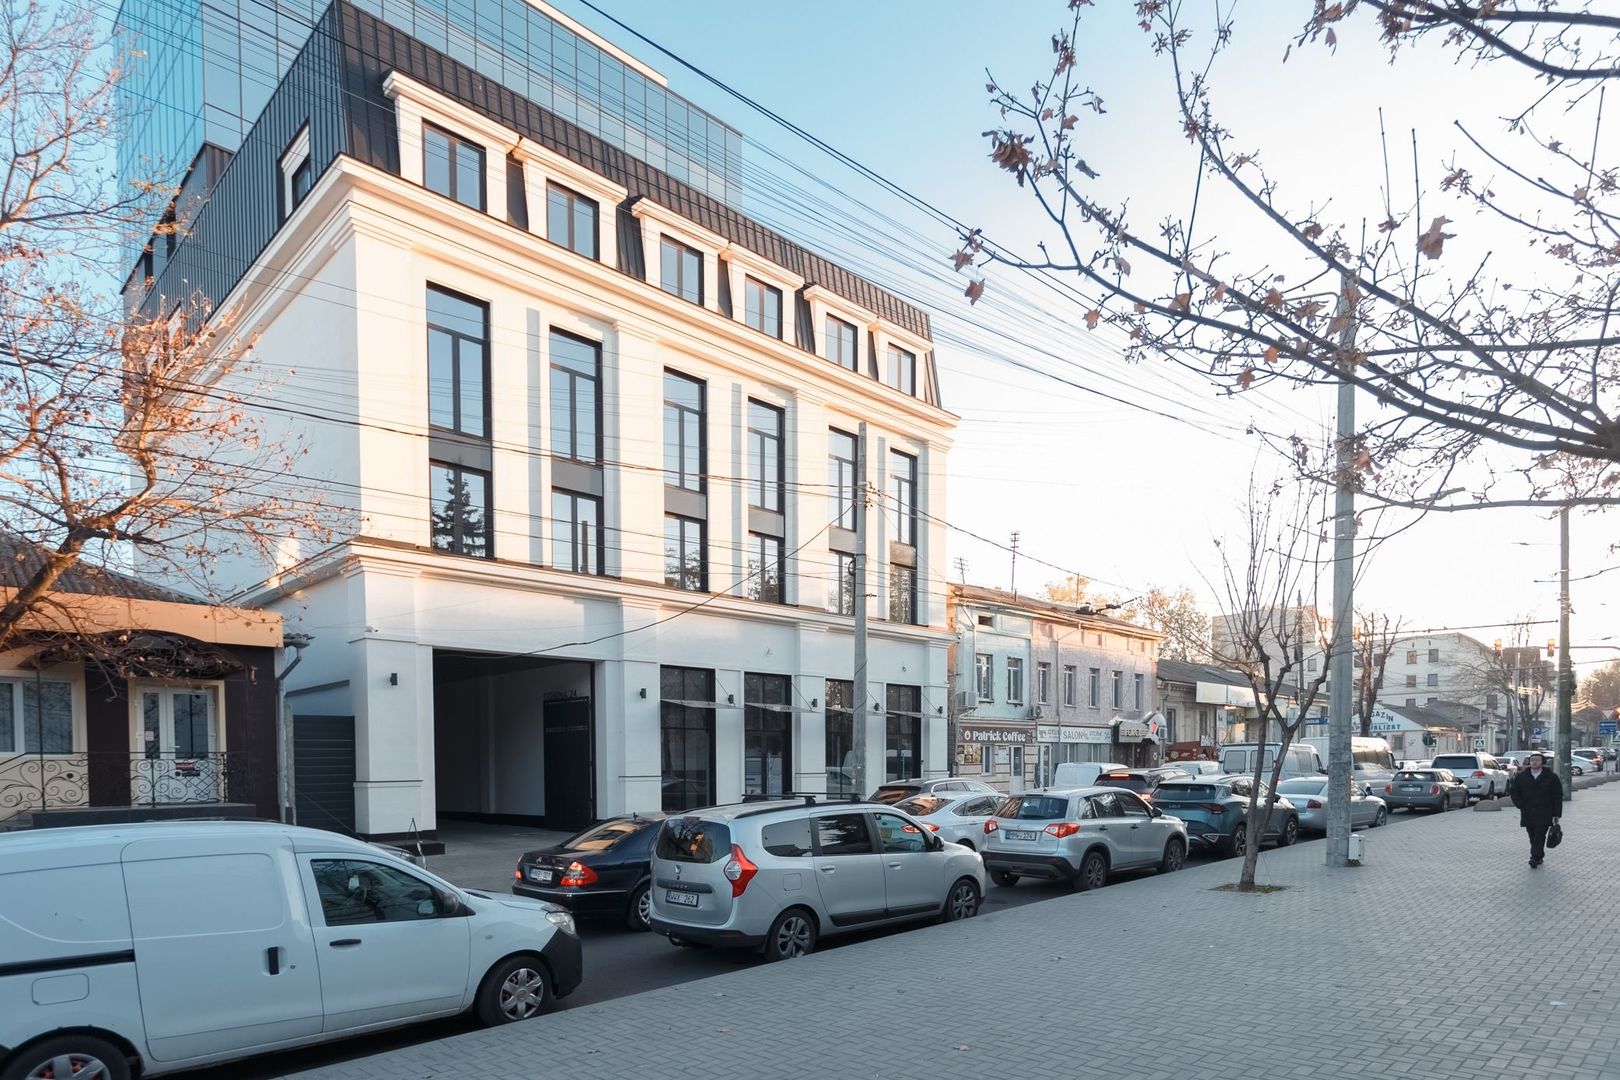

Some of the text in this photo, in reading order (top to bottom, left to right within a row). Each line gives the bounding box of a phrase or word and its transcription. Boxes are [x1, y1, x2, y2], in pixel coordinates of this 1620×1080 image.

[972, 730, 1002, 742] Patrick
[1002, 731, 1026, 742] Coffee
[1063, 730, 1083, 740] SALON
